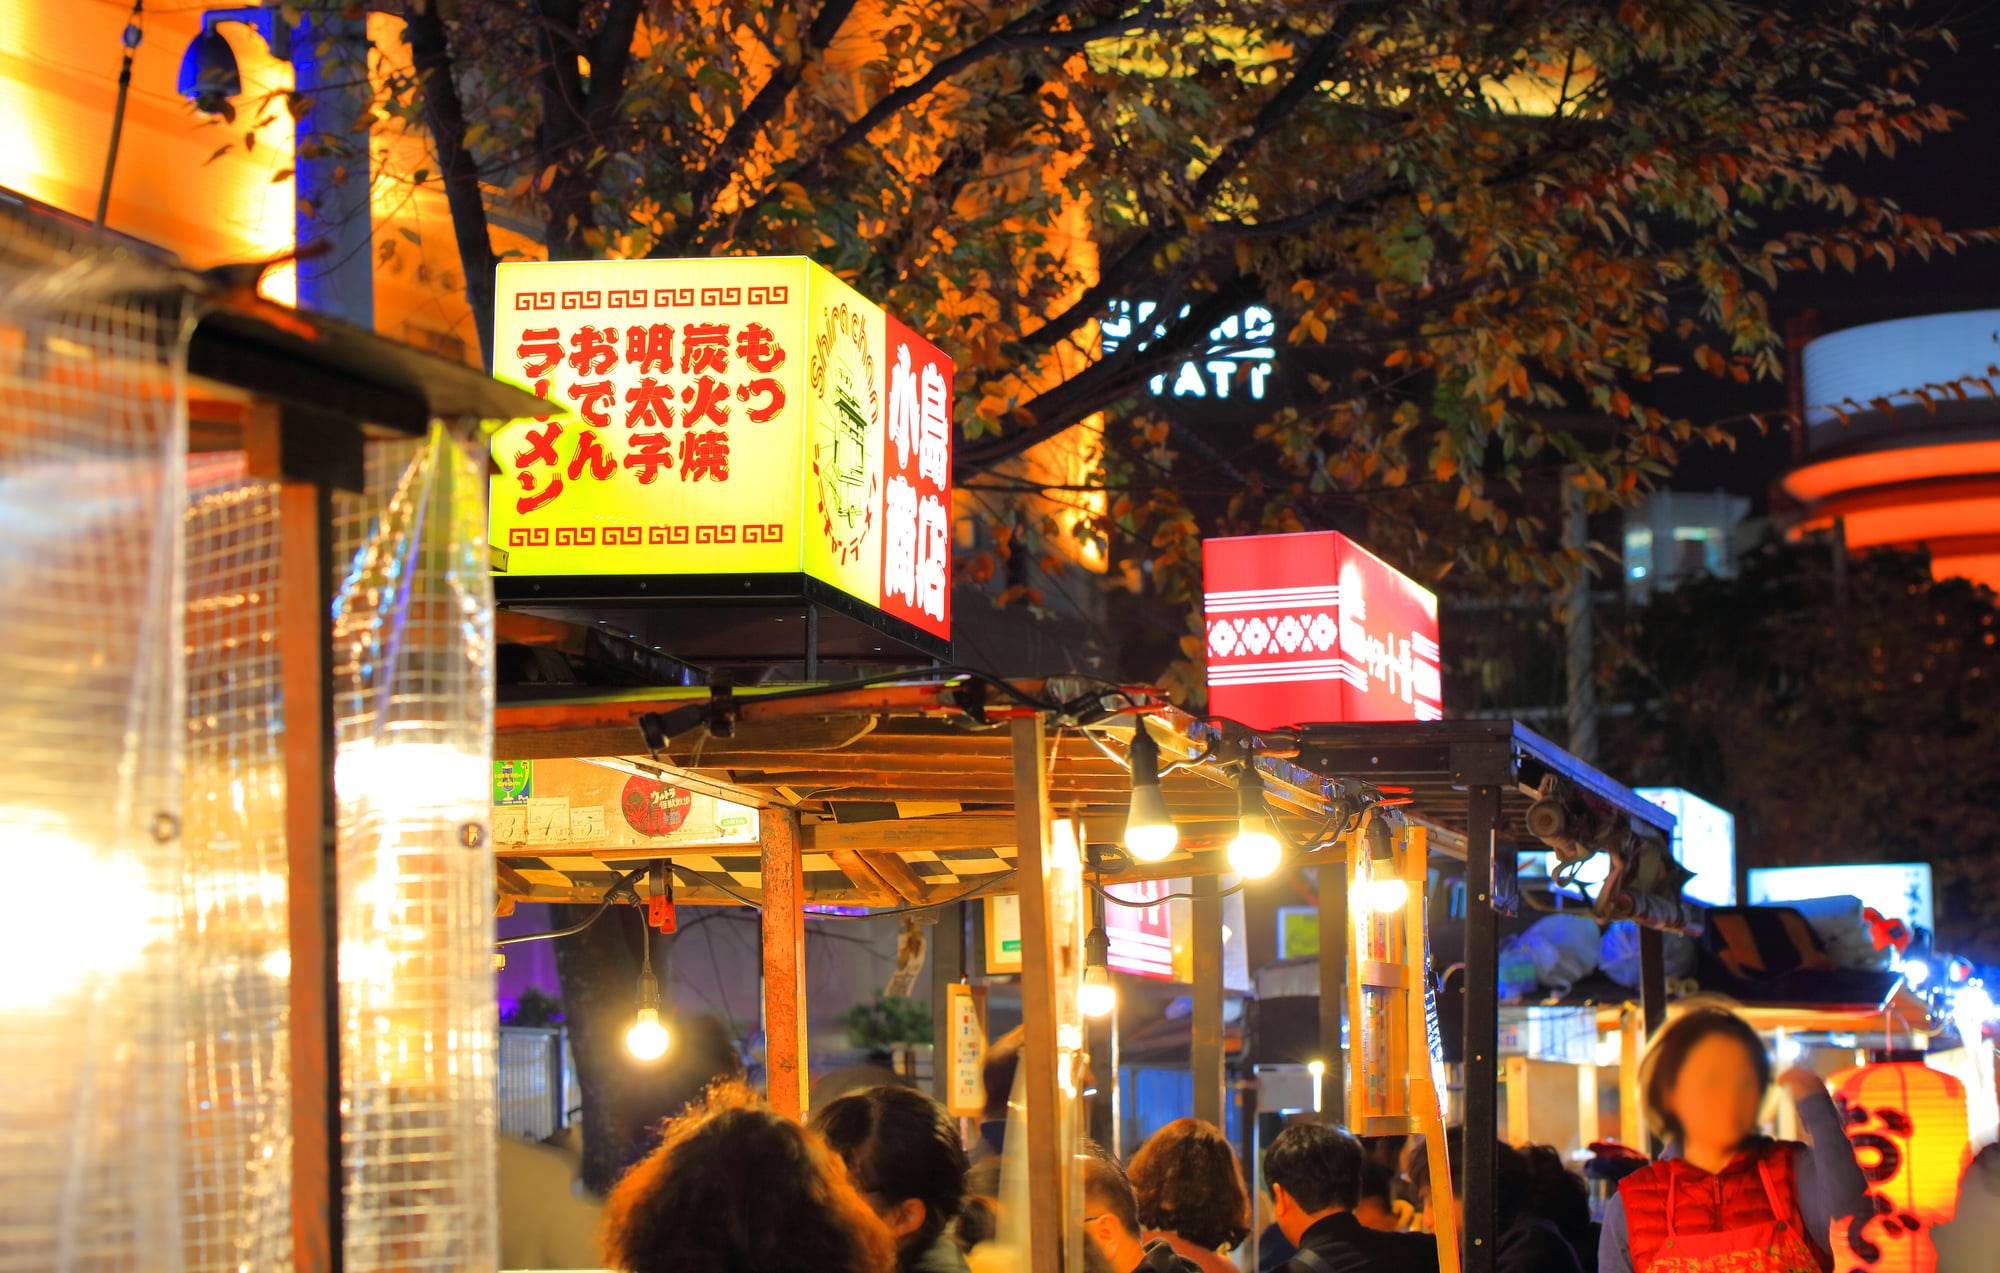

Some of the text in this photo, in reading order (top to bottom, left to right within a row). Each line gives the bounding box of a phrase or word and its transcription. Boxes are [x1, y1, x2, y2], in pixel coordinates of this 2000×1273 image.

[514, 326, 566, 515] ラーメン
[568, 325, 620, 481] おでん
[623, 322, 676, 485] 明太子
[679, 322, 732, 483] 炭火焼
[735, 322, 786, 423] もつ
